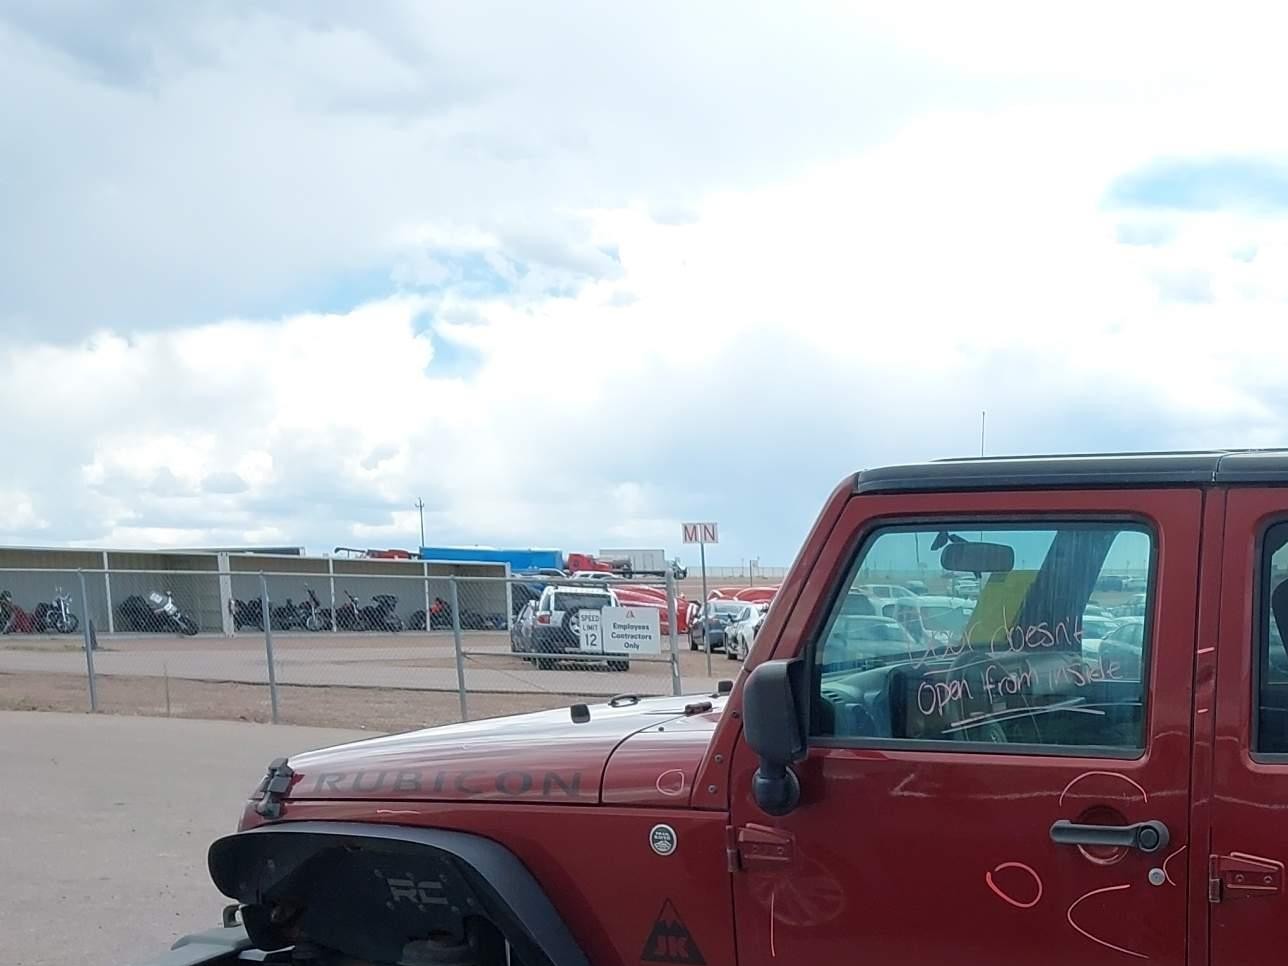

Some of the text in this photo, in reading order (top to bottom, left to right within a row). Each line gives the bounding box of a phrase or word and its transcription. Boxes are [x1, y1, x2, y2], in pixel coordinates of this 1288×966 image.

[612, 622, 649, 631] Employees
[990, 606, 1084, 653] doesn't
[585, 633, 597, 647] 12
[611, 632, 652, 640] Contractors
[624, 642, 640, 650] Only
[311, 769, 582, 798] RUBICON
[386, 878, 449, 905] RC
